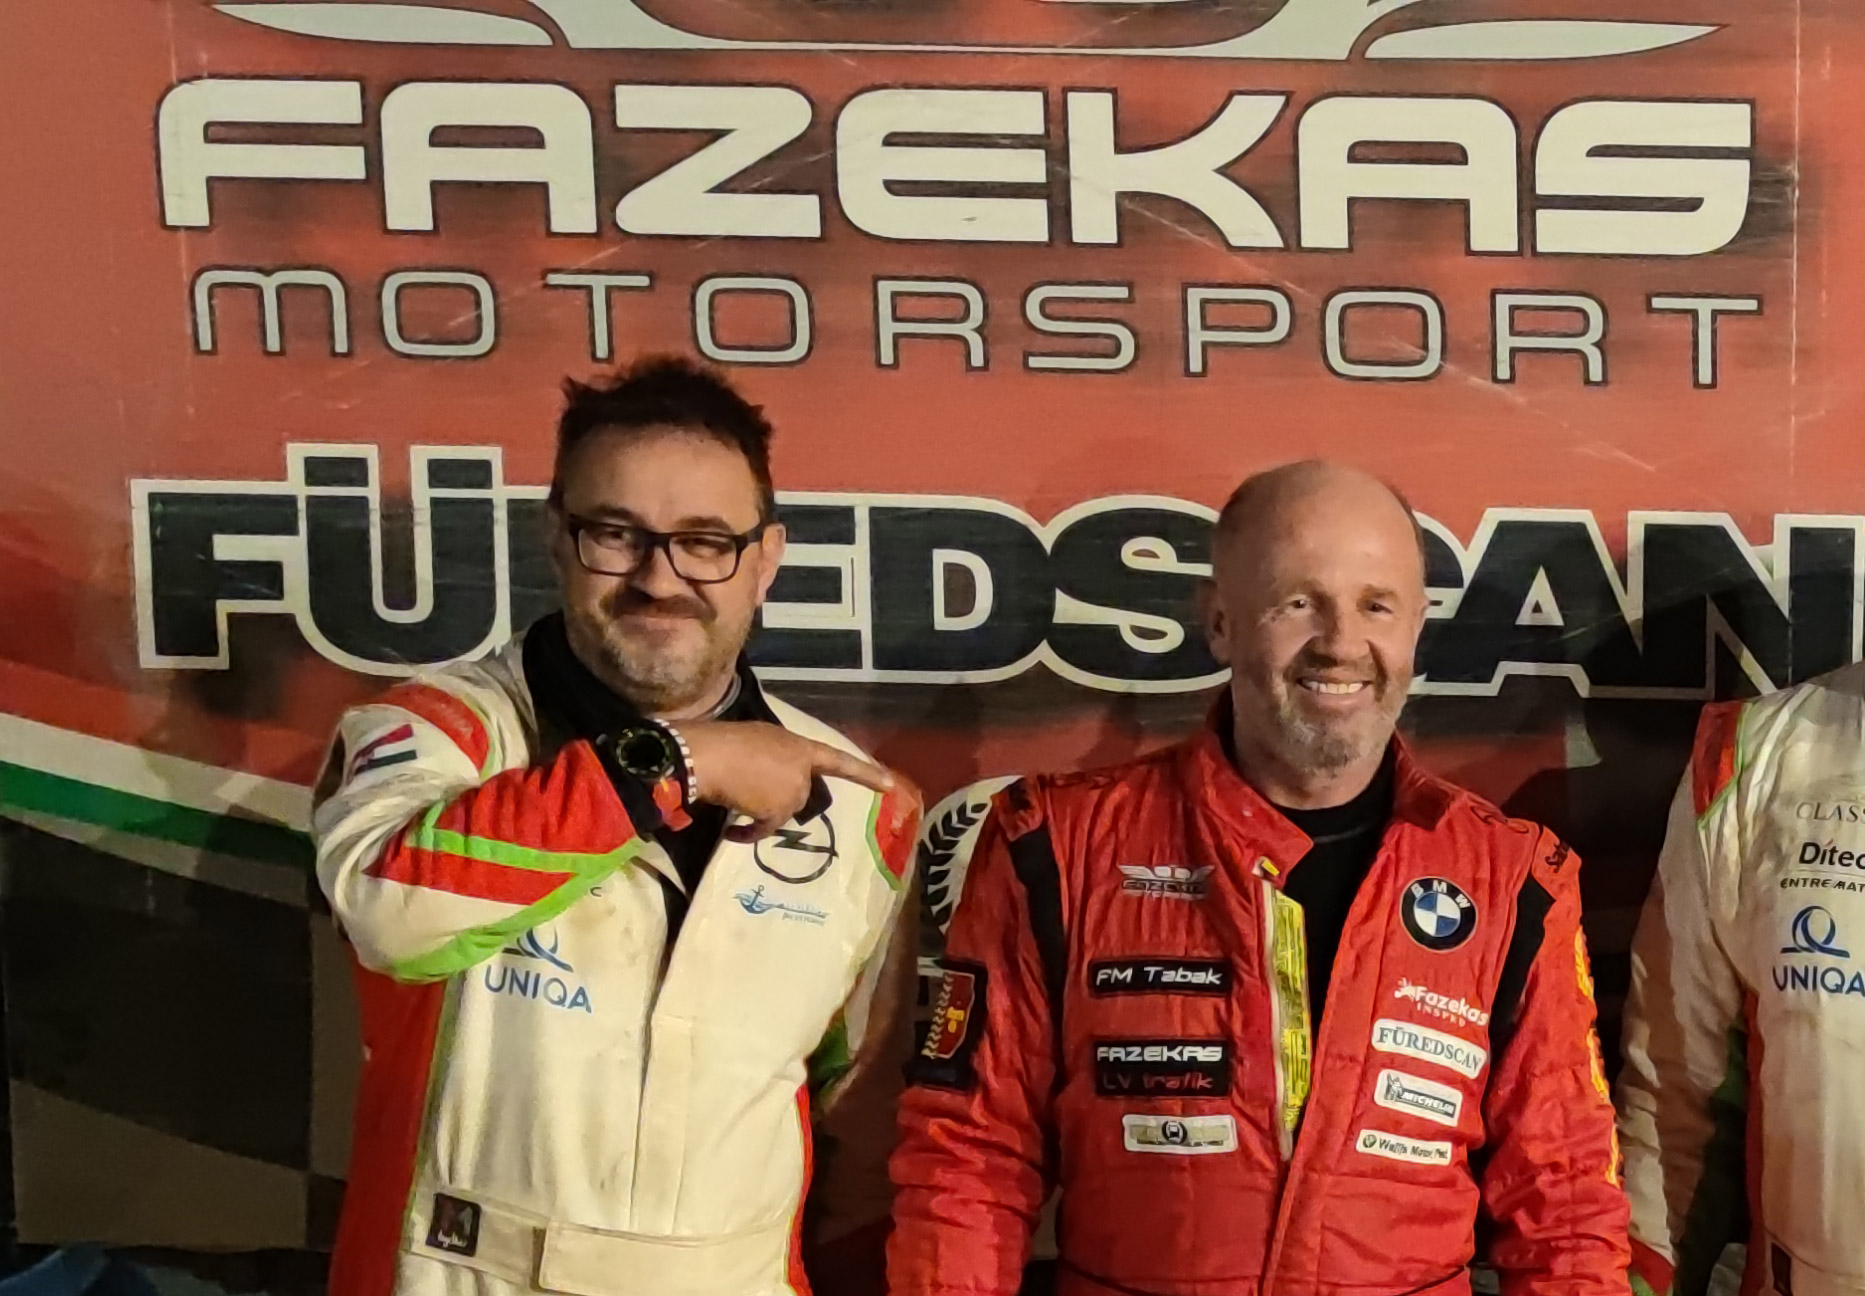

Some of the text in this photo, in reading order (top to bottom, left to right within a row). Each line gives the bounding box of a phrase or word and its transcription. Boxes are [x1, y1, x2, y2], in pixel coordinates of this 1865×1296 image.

[157, 77, 1756, 257] FAZEKAS
[191, 267, 1763, 389] MOTORSPORT
[1410, 879, 1471, 909] BMW
[484, 963, 592, 1014] UNIQA
[1096, 965, 1223, 986] FM Tabak
[1414, 985, 1490, 1027] Fazekas
[1096, 1045, 1223, 1063] FAZEKAS
[1376, 1025, 1482, 1072] FÜREDSCAN
[1401, 1092, 1455, 1116] MICHELIN
